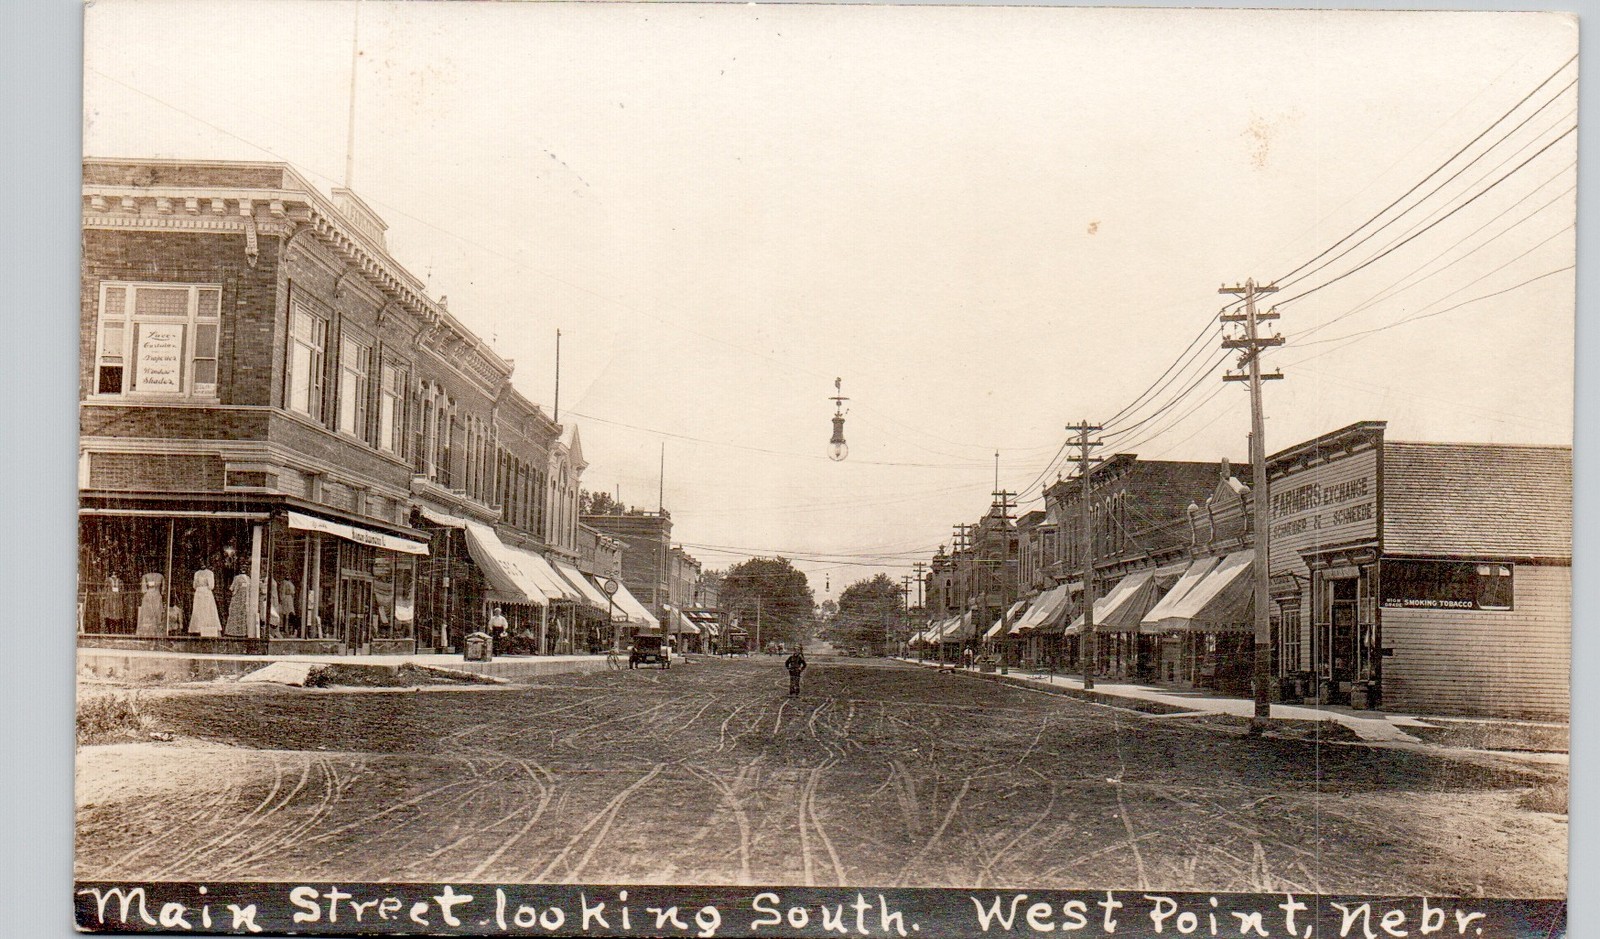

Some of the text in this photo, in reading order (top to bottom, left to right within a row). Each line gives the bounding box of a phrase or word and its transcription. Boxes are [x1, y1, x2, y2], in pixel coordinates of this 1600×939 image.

[1273, 477, 1368, 519] FARMERS EXCHANGE
[1439, 600, 1473, 608] TOBACCO
